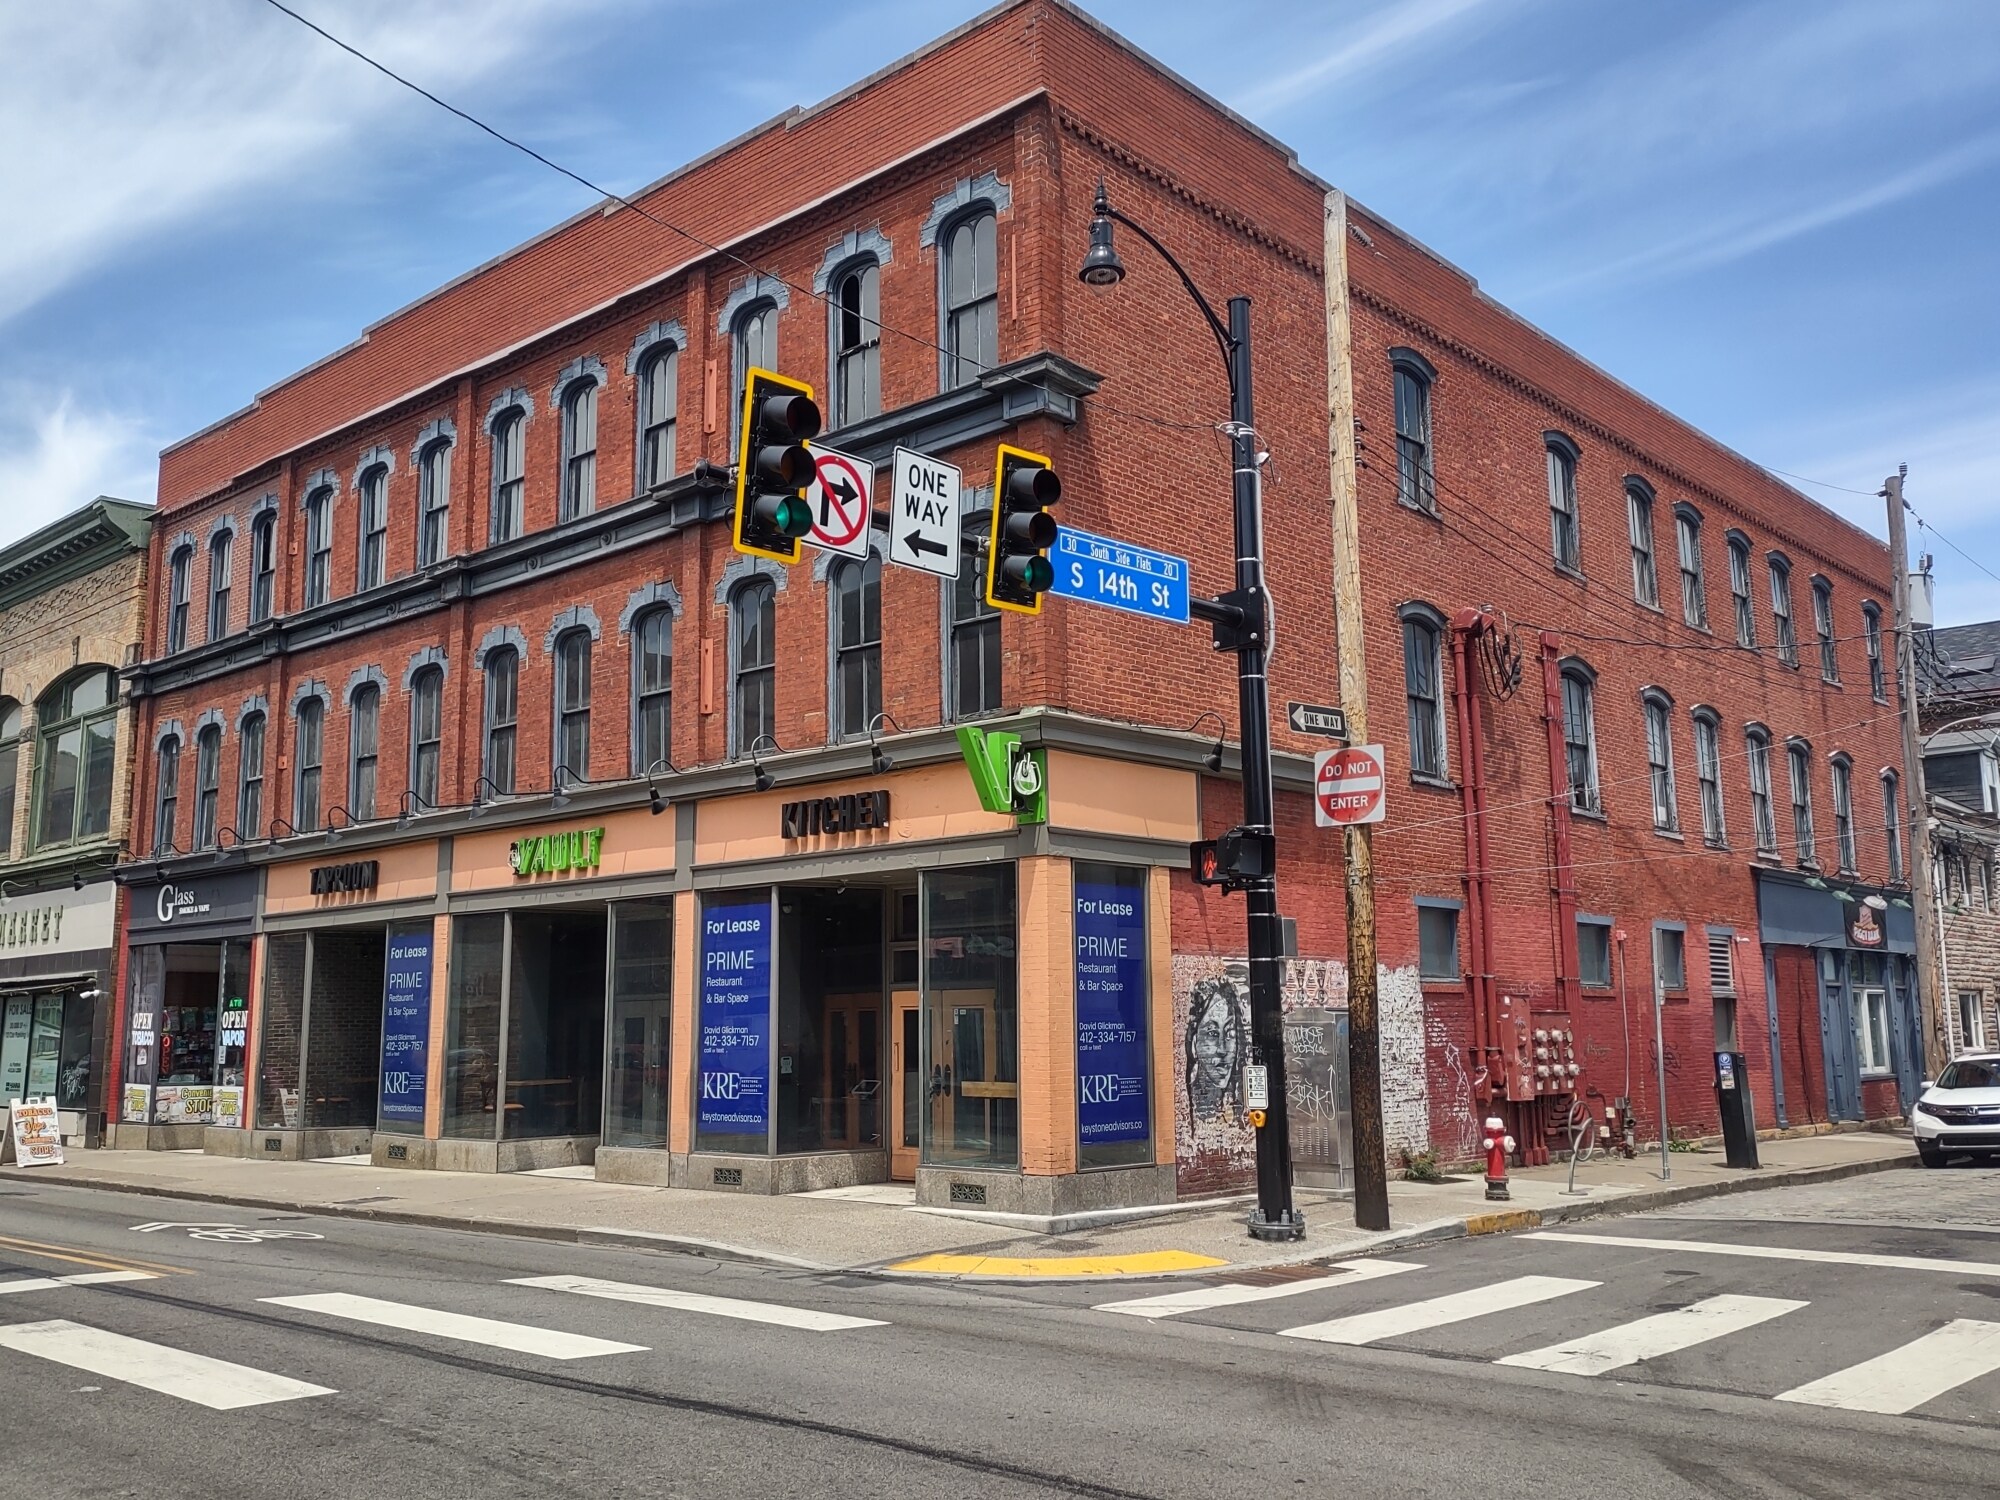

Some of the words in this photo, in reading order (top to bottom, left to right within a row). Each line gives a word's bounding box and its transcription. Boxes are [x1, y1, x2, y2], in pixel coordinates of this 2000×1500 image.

[908, 464, 948, 498] ONE
[905, 493, 949, 527] WAY
[1066, 537, 1077, 552] 30
[1090, 543, 1110, 561] South
[1115, 550, 1131, 566] Side
[1136, 555, 1152, 571] Flats
[1163, 563, 1173, 577] 20
[1070, 562, 1084, 589] S
[1098, 568, 1138, 602] 14th
[1151, 582, 1170, 609] St
[1304, 712, 1320, 726] ONE
[1322, 715, 1339, 729] WAY
[1325, 764, 1342, 778] DO
[1347, 761, 1373, 775] NOT
[1330, 795, 1369, 810] ENTER
[782, 790, 891, 839] KITCHEN
[516, 827, 605, 875] VAULT
[310, 860, 379, 895] TAPROOM
[157, 884, 194, 922] Glass
[1077, 898, 1096, 914] For
[1099, 900, 1133, 916] Lease
[706, 920, 724, 935] For
[727, 919, 761, 933] Lease
[390, 947, 403, 959] For
[404, 946, 427, 958] Lease
[1078, 936, 1127, 957] PRIME
[707, 950, 754, 971] PRIME
[1078, 962, 1117, 974] Restaurant
[389, 972, 422, 989] PRIME
[706, 976, 742, 987] Restaurant
[1079, 980, 1085, 991] &
[1087, 980, 1099, 991] Bar
[1101, 980, 1124, 993] Space
[388, 993, 413, 1002] Restaurant
[706, 993, 712, 1004] &
[714, 993, 725, 1004] Bar
[727, 993, 749, 1006] Space
[9, 1004, 20, 1016] FOR
[19, 1003, 32, 1015] SALE
[388, 1007, 392, 1016] &
[393, 1007, 402, 1016] Bar
[402, 1007, 417, 1018] Space
[133, 1012, 154, 1030] OPEN
[222, 1010, 249, 1029] OPEN
[1079, 1022, 1096, 1031] David
[1097, 1022, 1126, 1031] Glickman
[131, 1030, 154, 1046] TOBACCO
[221, 1029, 245, 1048] VAPOR
[704, 1026, 720, 1034] David
[722, 1026, 748, 1034] Glickman
[1079, 1031, 1137, 1043] 412-334-7157
[385, 1041, 424, 1051] 412-334-7157
[703, 1035, 760, 1047] 412-334-7157
[162, 1036, 171, 1074] OPEN
[384, 1071, 409, 1094] KRE
[702, 1072, 740, 1099] KRE
[1080, 1074, 1120, 1104] KRE
[17, 1108, 53, 1118] TOBACCO
[702, 1111, 762, 1124] keystoneadvisors.co
[1081, 1121, 1143, 1136] keystoneadvisors.co
[30, 1145, 55, 1156] STORE
